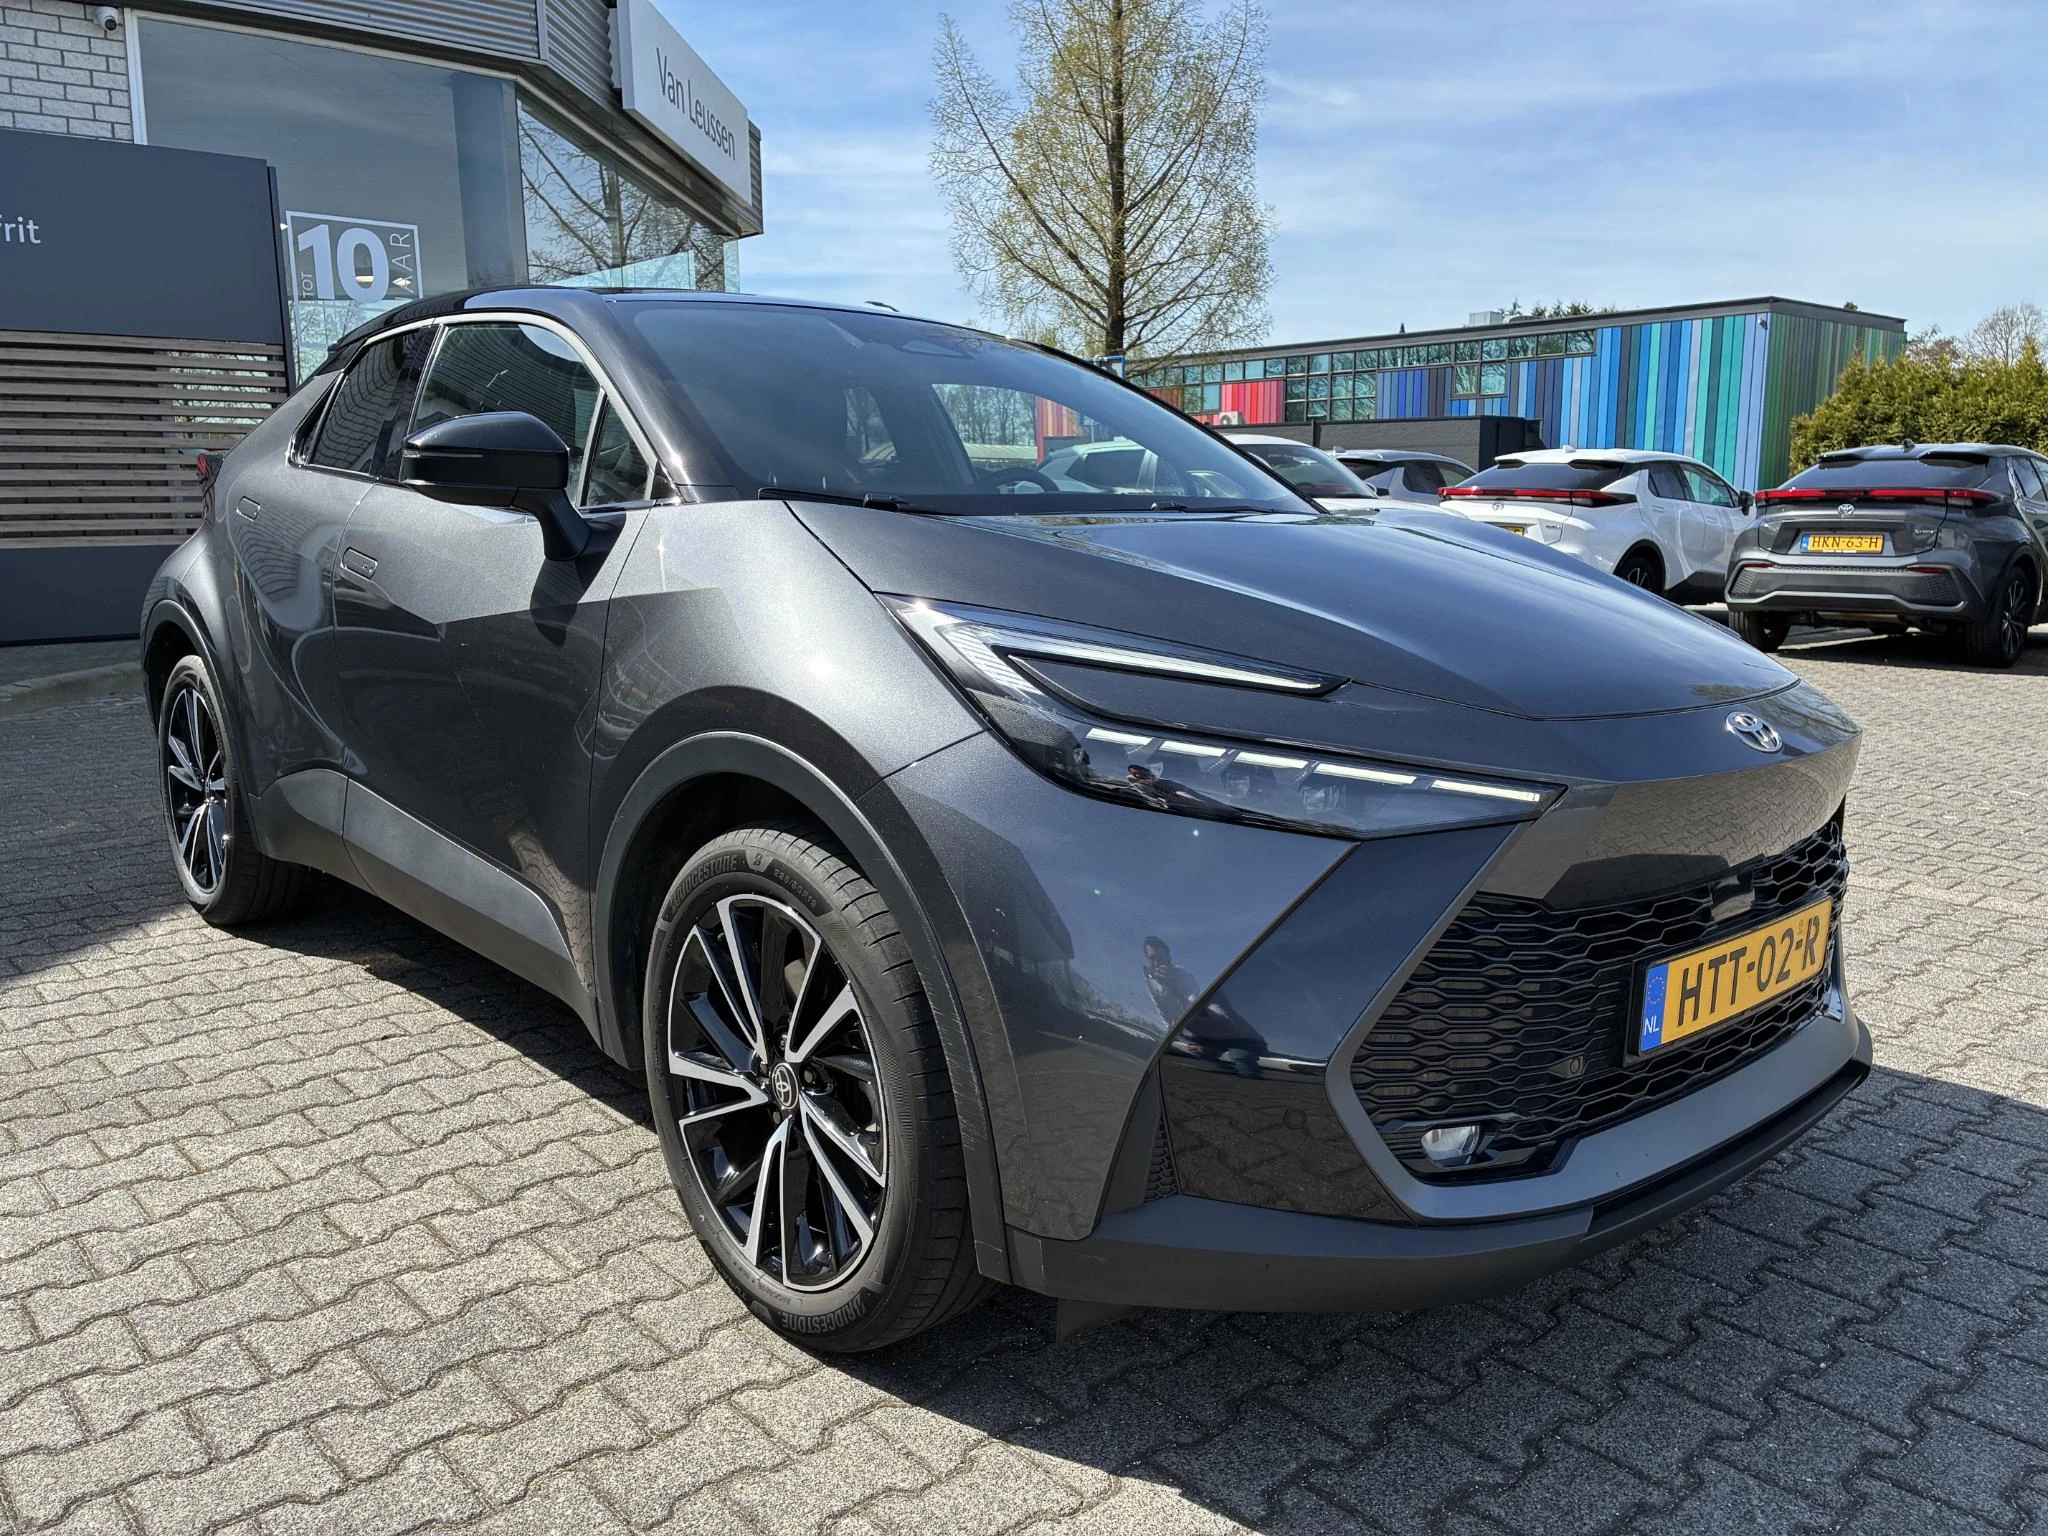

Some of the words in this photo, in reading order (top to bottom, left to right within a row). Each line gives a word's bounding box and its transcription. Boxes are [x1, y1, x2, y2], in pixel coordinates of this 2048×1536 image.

[656, 47, 685, 114] Van
[688, 79, 736, 160] Leussen
[0, 214, 42, 244] rit
[297, 224, 390, 303] 10
[301, 271, 314, 298] TOT
[1811, 536, 1879, 549] HKN-63-H
[668, 854, 738, 912] BRIDGESTONE
[1677, 915, 1820, 1027] HTT-02-R
[1643, 1015, 1660, 1036] NL
[781, 1293, 867, 1334] BRIDGESTONE
